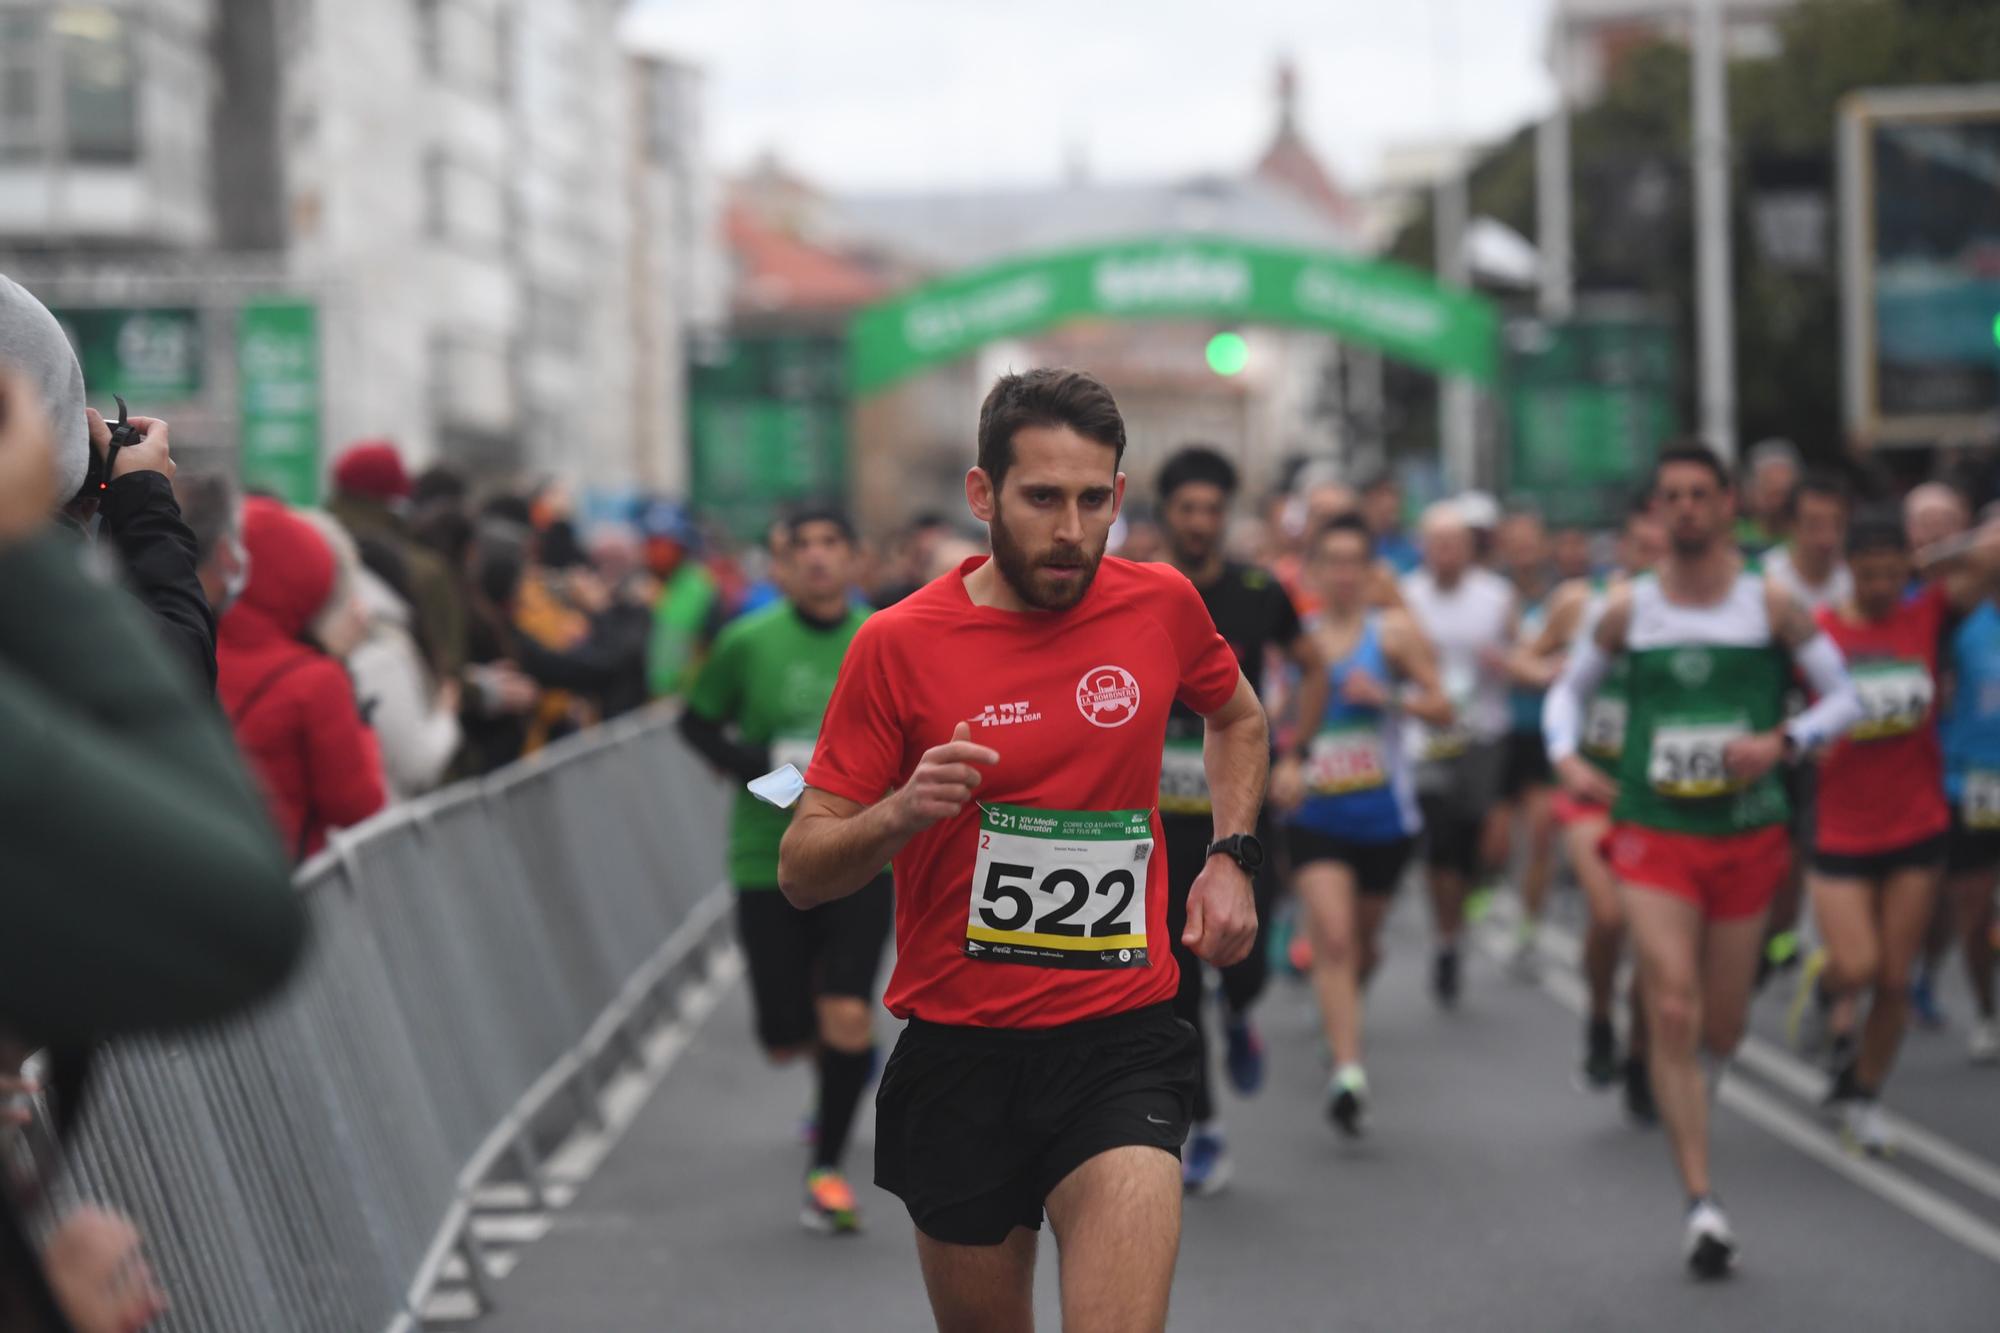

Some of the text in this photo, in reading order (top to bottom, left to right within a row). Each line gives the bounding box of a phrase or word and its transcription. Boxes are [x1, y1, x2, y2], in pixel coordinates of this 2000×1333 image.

[1082, 688, 1136, 704] LA BOMBONERA
[1019, 823, 1052, 833] Maratón
[1020, 816, 1058, 827] XIV Media
[981, 834, 990, 850] 2
[978, 861, 1135, 938] 522
